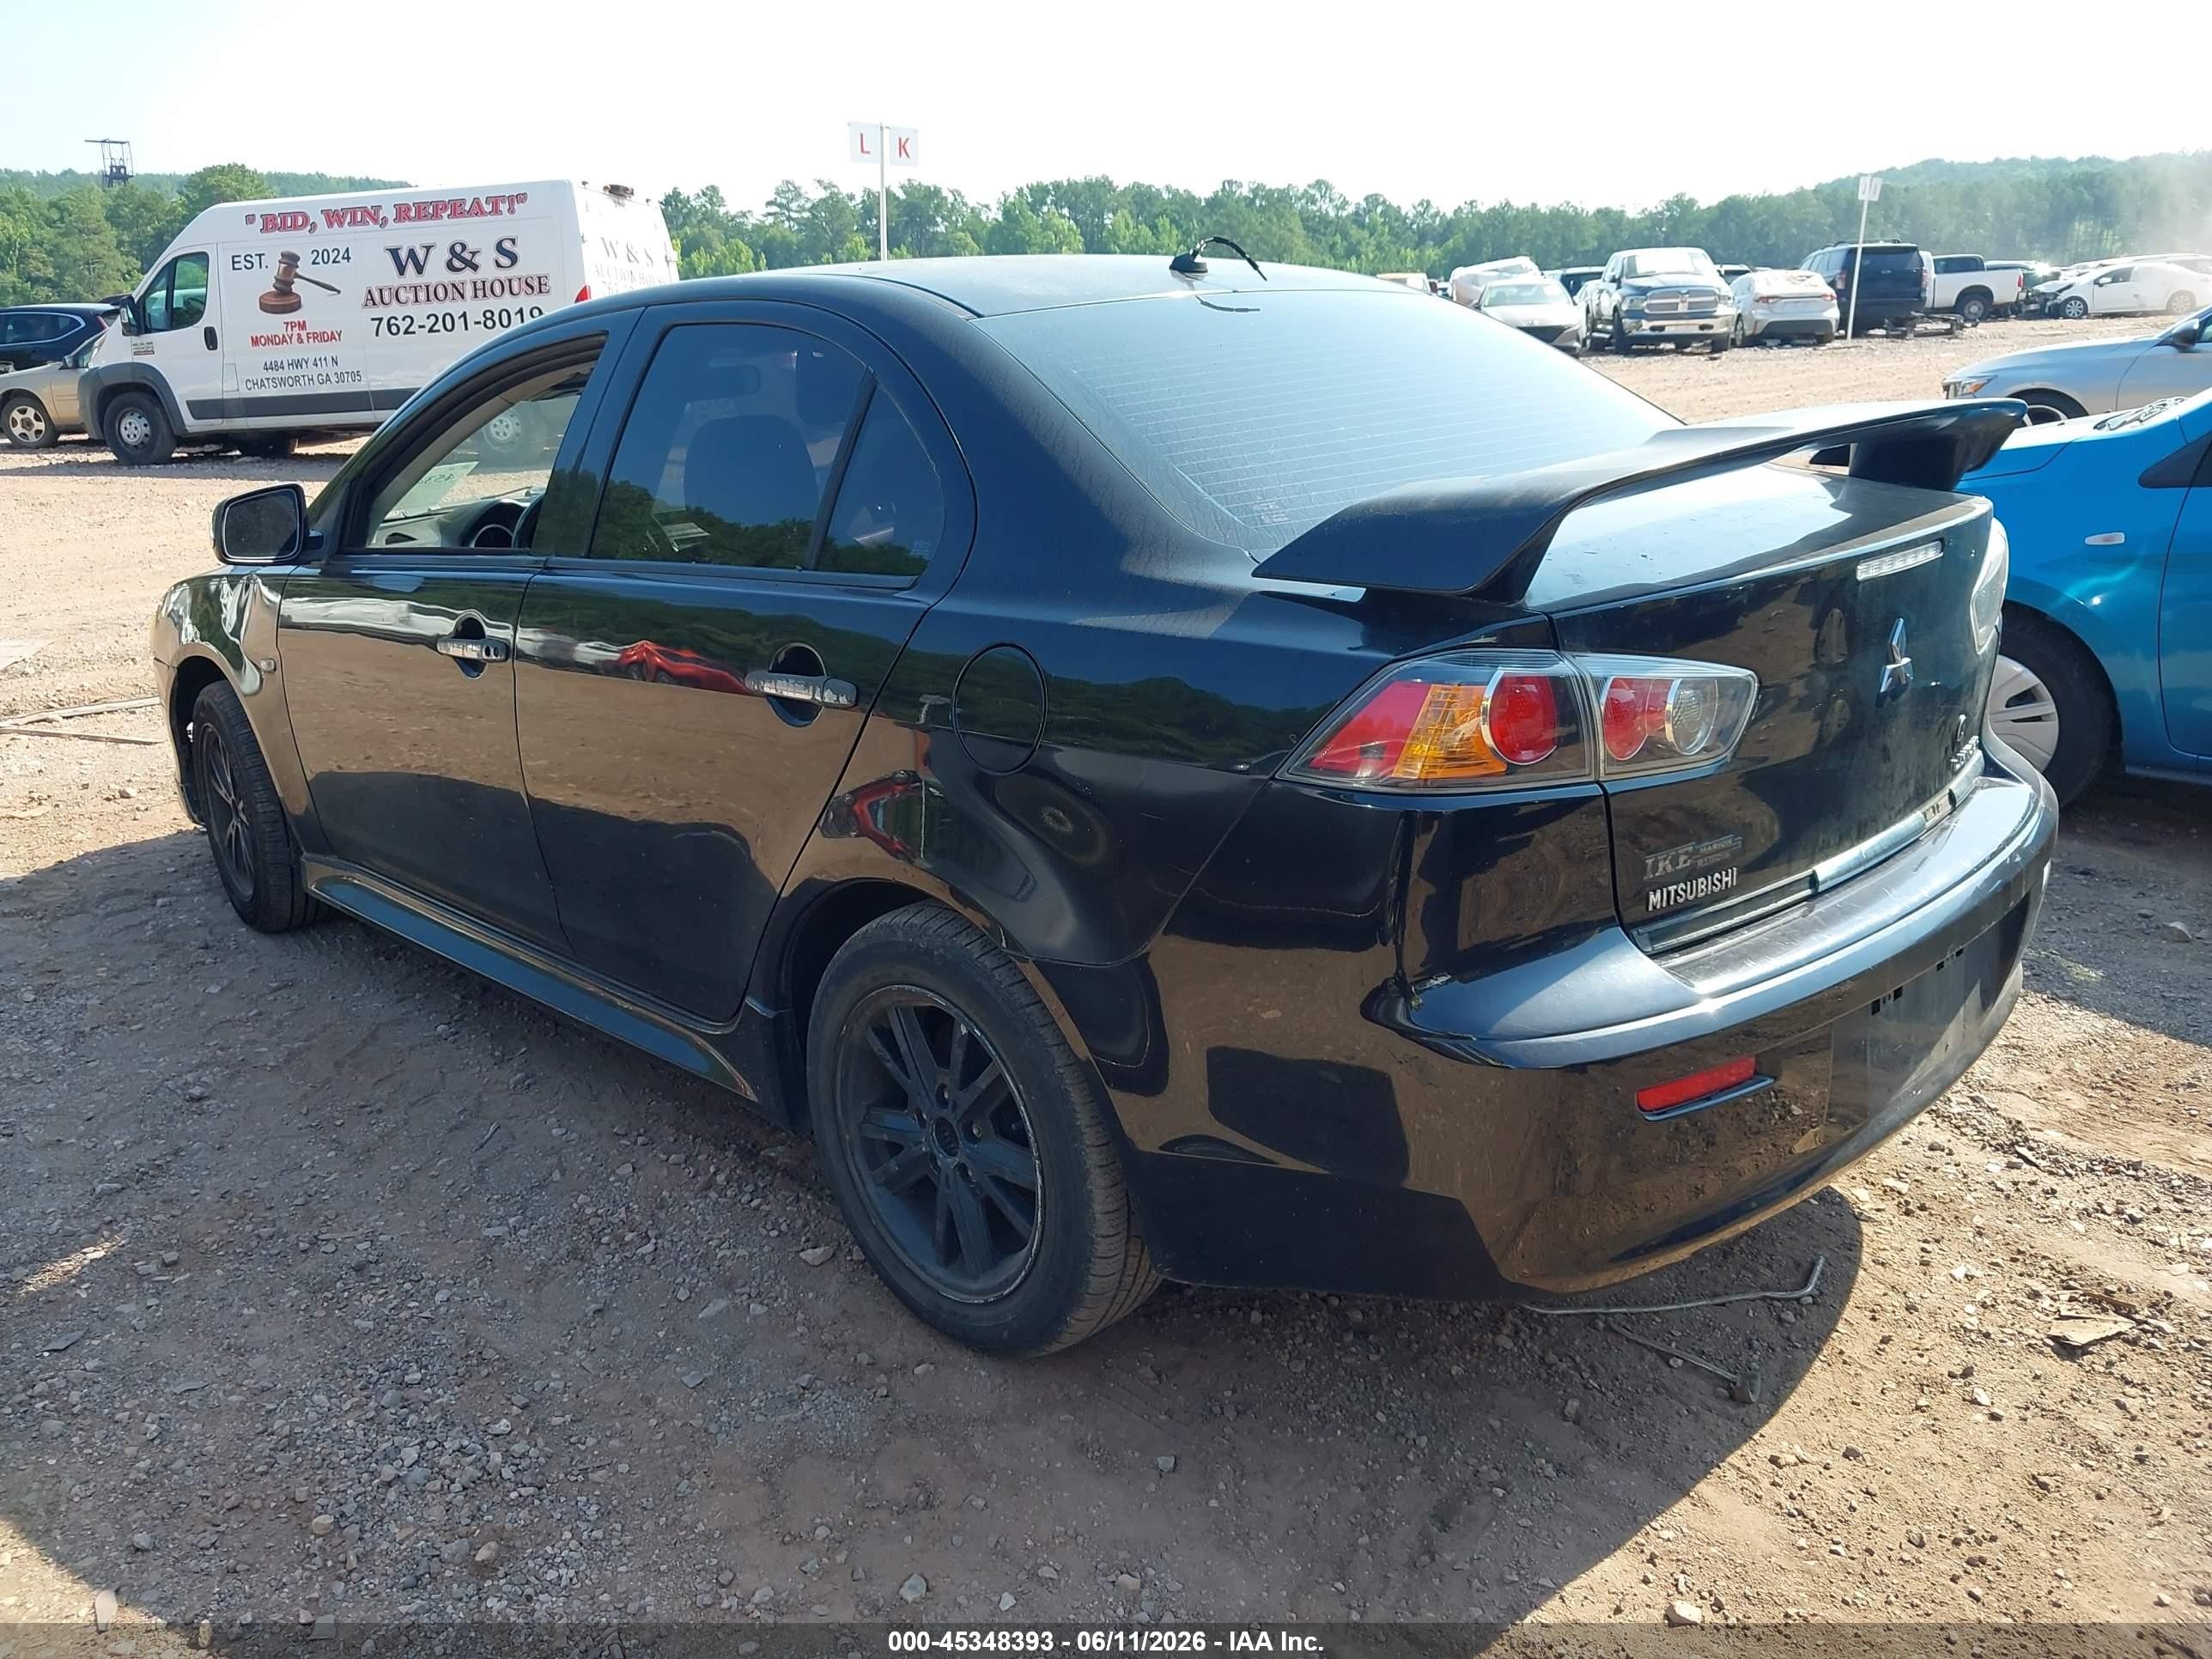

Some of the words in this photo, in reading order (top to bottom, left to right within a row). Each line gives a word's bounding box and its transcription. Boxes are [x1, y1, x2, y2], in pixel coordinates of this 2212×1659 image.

[860, 132, 871, 155] L
[898, 137, 910, 158] K
[321, 205, 389, 229] WIN,
[393, 192, 528, 224] REPEAT!"
[231, 252, 269, 271] EST.
[311, 246, 352, 266] 2024
[384, 242, 436, 278] W
[445, 240, 483, 274] &
[493, 235, 520, 270] S
[362, 280, 466, 308] AUCTION
[471, 274, 550, 300] HOUSE
[283, 320, 307, 332] 7PM
[250, 333, 294, 347] MONDAY
[296, 332, 305, 343] &
[307, 330, 343, 343] FRIDAY
[263, 359, 285, 372] 4484
[287, 356, 309, 370] HWY
[313, 356, 328, 368] 411
[331, 355, 338, 367] N
[245, 374, 314, 391] CHATSWORTH
[317, 372, 332, 385] GA
[335, 370, 362, 383] 30705
[1647, 866, 1739, 912] MITSUBISHI
